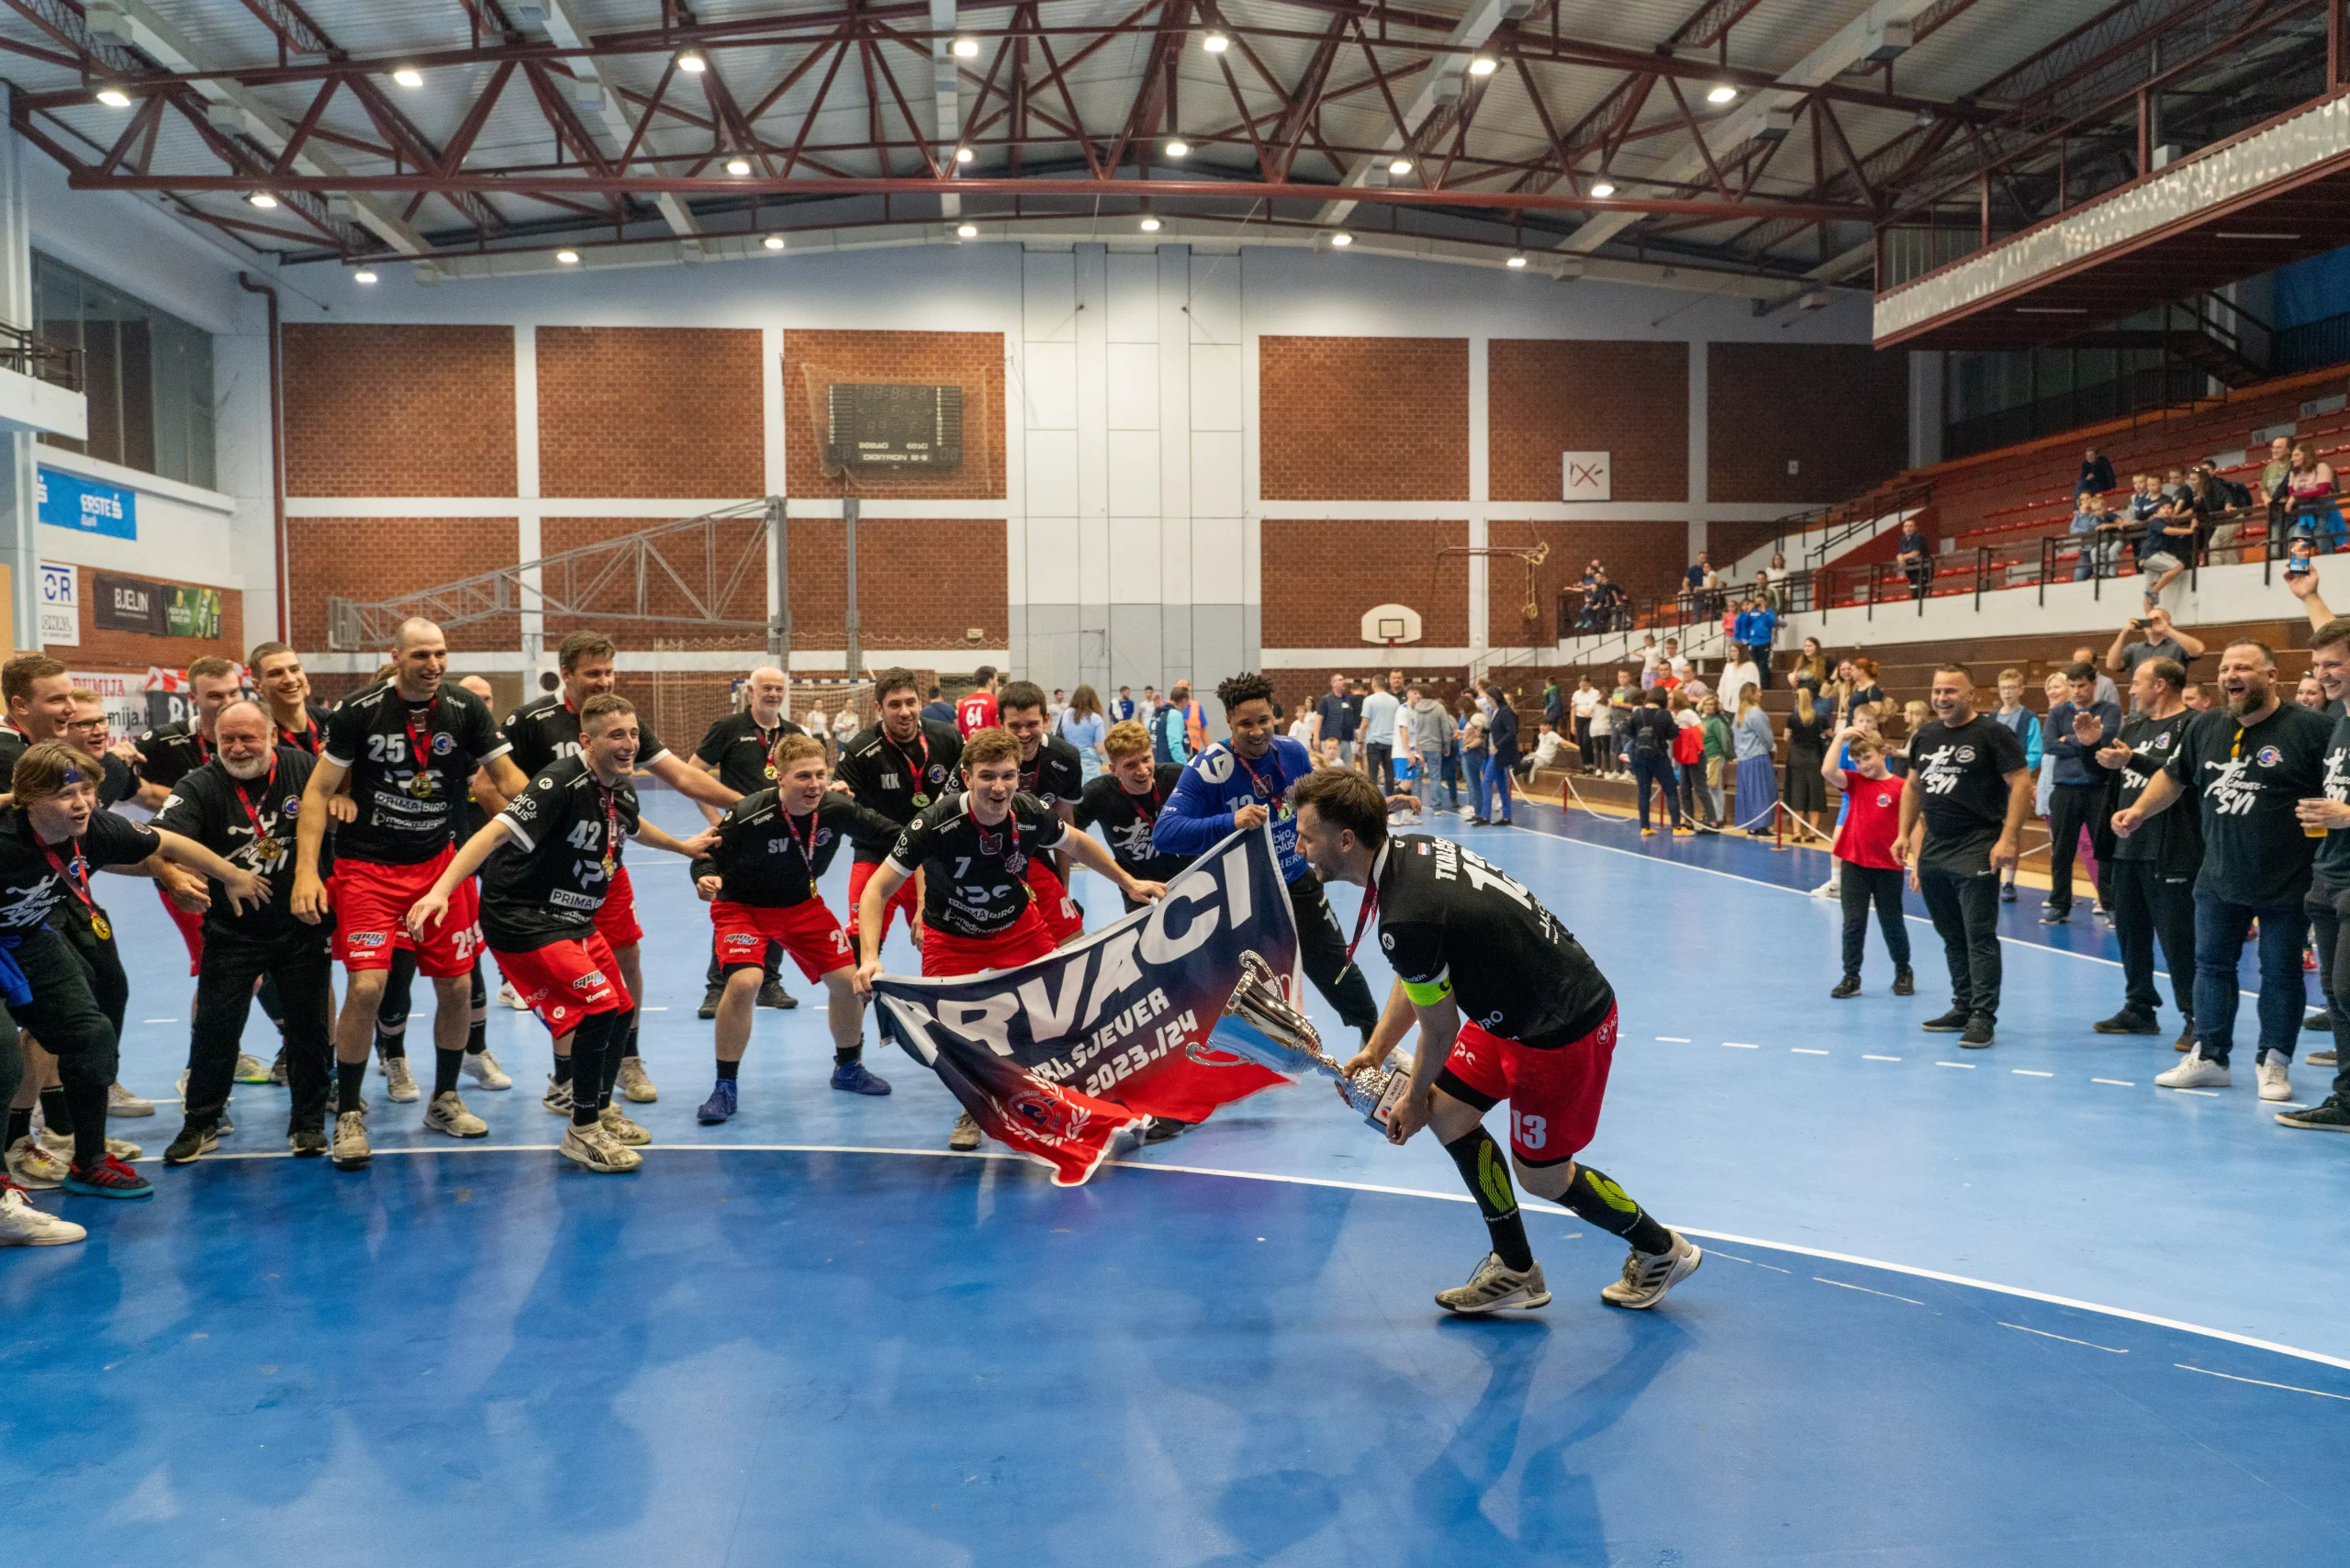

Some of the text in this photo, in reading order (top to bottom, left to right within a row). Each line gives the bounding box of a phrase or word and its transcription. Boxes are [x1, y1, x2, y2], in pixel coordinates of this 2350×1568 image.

[966, 706, 982, 726] 64
[368, 734, 405, 763] 25
[880, 772, 901, 790] KK
[1926, 774, 1959, 795] SVI
[421, 801, 448, 812] BIRO
[505, 801, 530, 822] plus
[513, 792, 537, 812] biro
[2215, 789, 2256, 815] SVI
[566, 820, 602, 852] 42
[940, 819, 961, 834] Kempa
[1272, 828, 1291, 845] biro
[767, 837, 789, 854] SV
[1275, 838, 1295, 856] plus
[953, 856, 971, 879] 7
[553, 890, 593, 910] PRIMA
[989, 904, 1015, 919] BIRO
[585, 988, 611, 1003] Kempa
[1029, 987, 1170, 1082] RL SJEVER
[1085, 1009, 1199, 1099] 2023./24
[1511, 1109, 1547, 1149] 13
